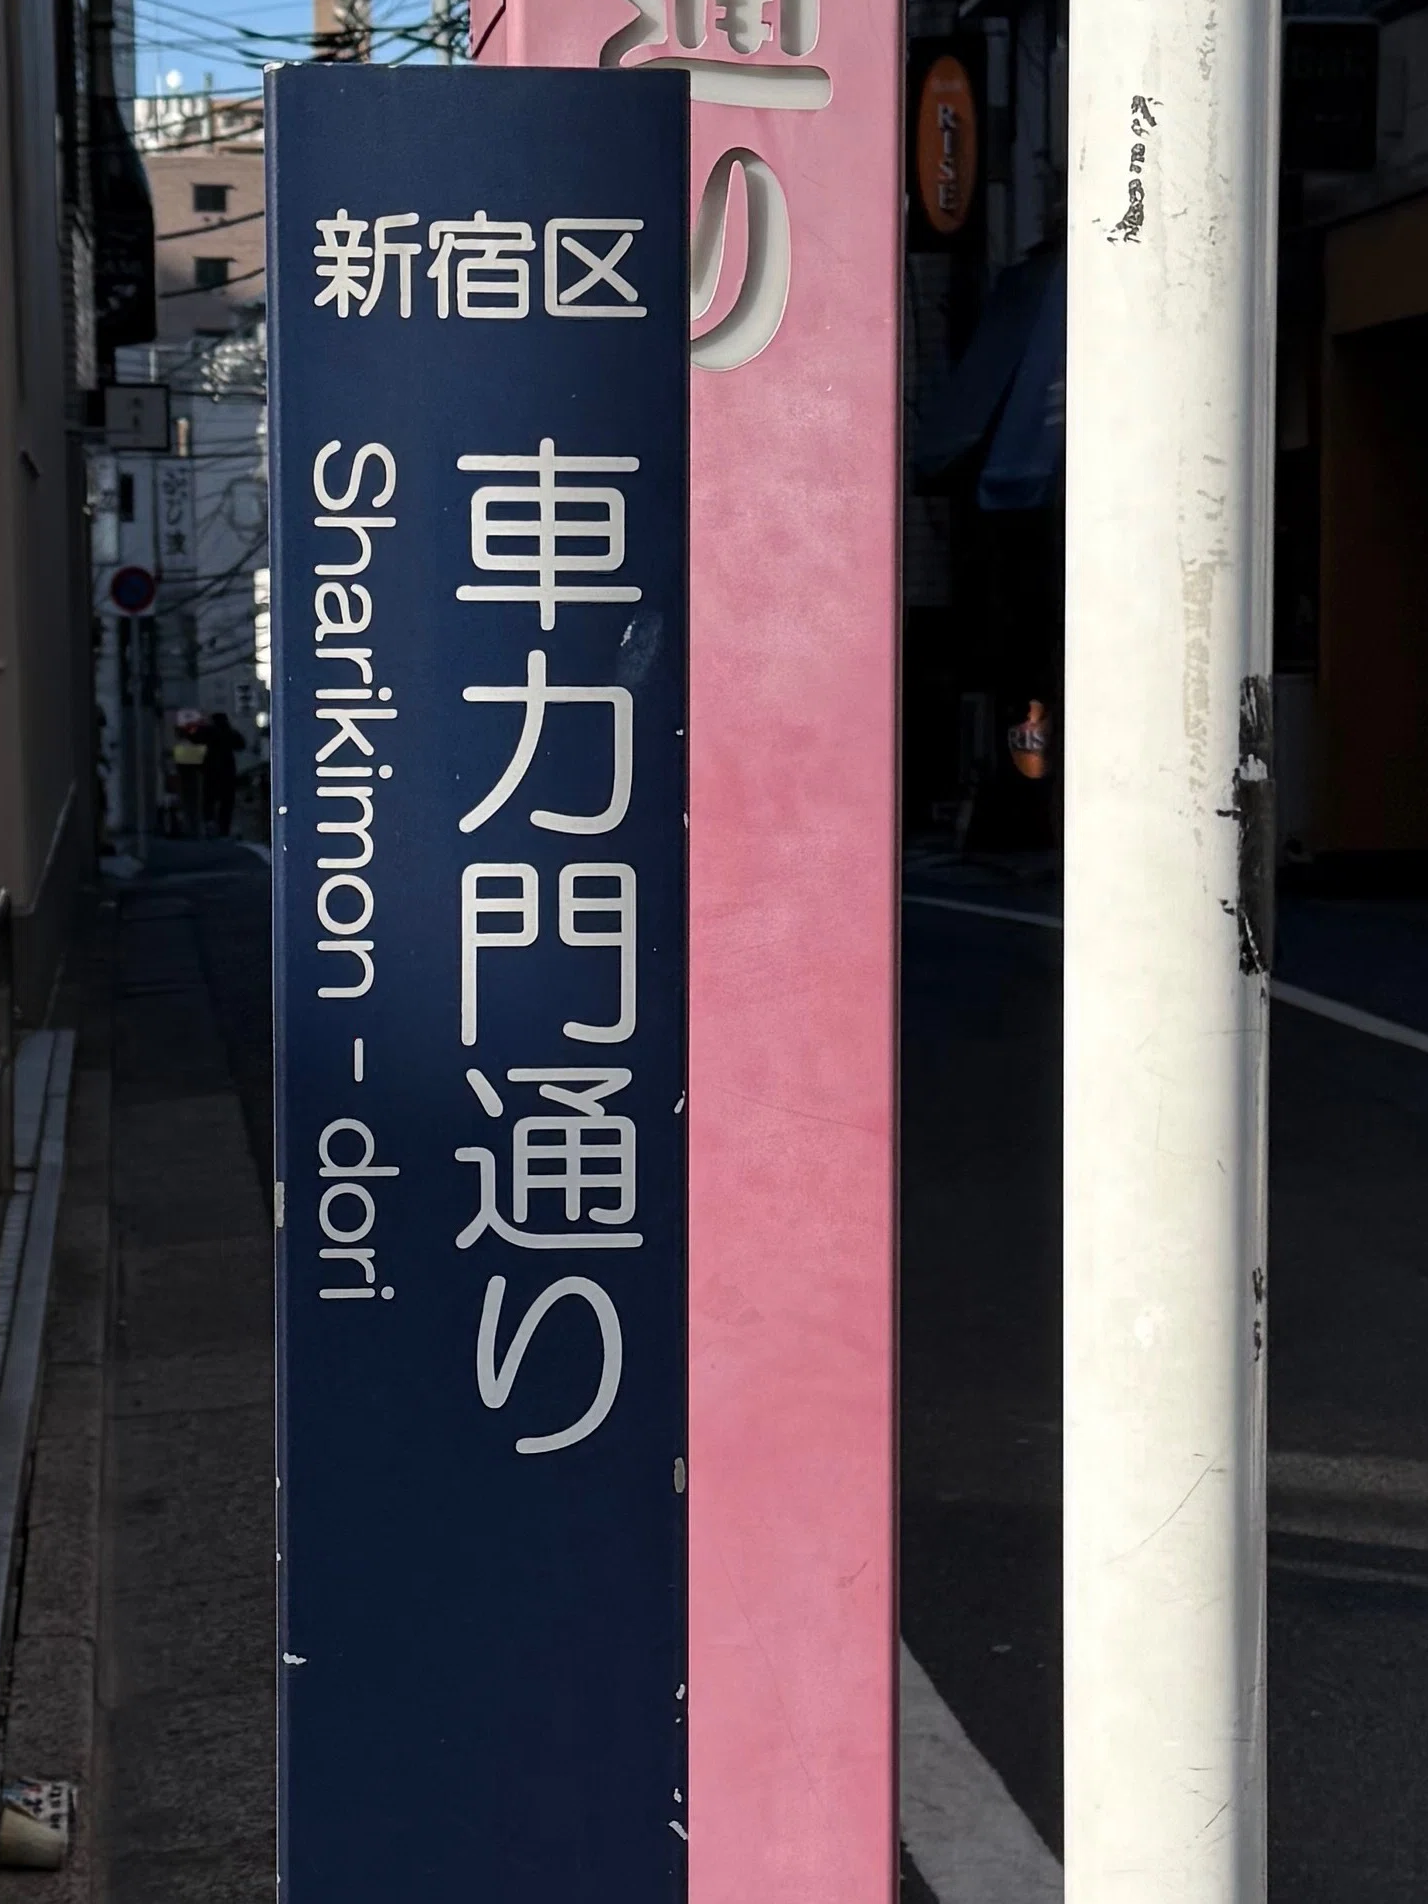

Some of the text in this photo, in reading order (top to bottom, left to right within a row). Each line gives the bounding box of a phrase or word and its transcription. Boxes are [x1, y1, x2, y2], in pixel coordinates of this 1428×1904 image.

[936, 103, 957, 210] RISE
[312, 207, 649, 319] 新宿区
[312, 439, 399, 999] Sharikimon
[455, 436, 645, 1455] 車力門通り
[317, 1117, 401, 1301] dori
